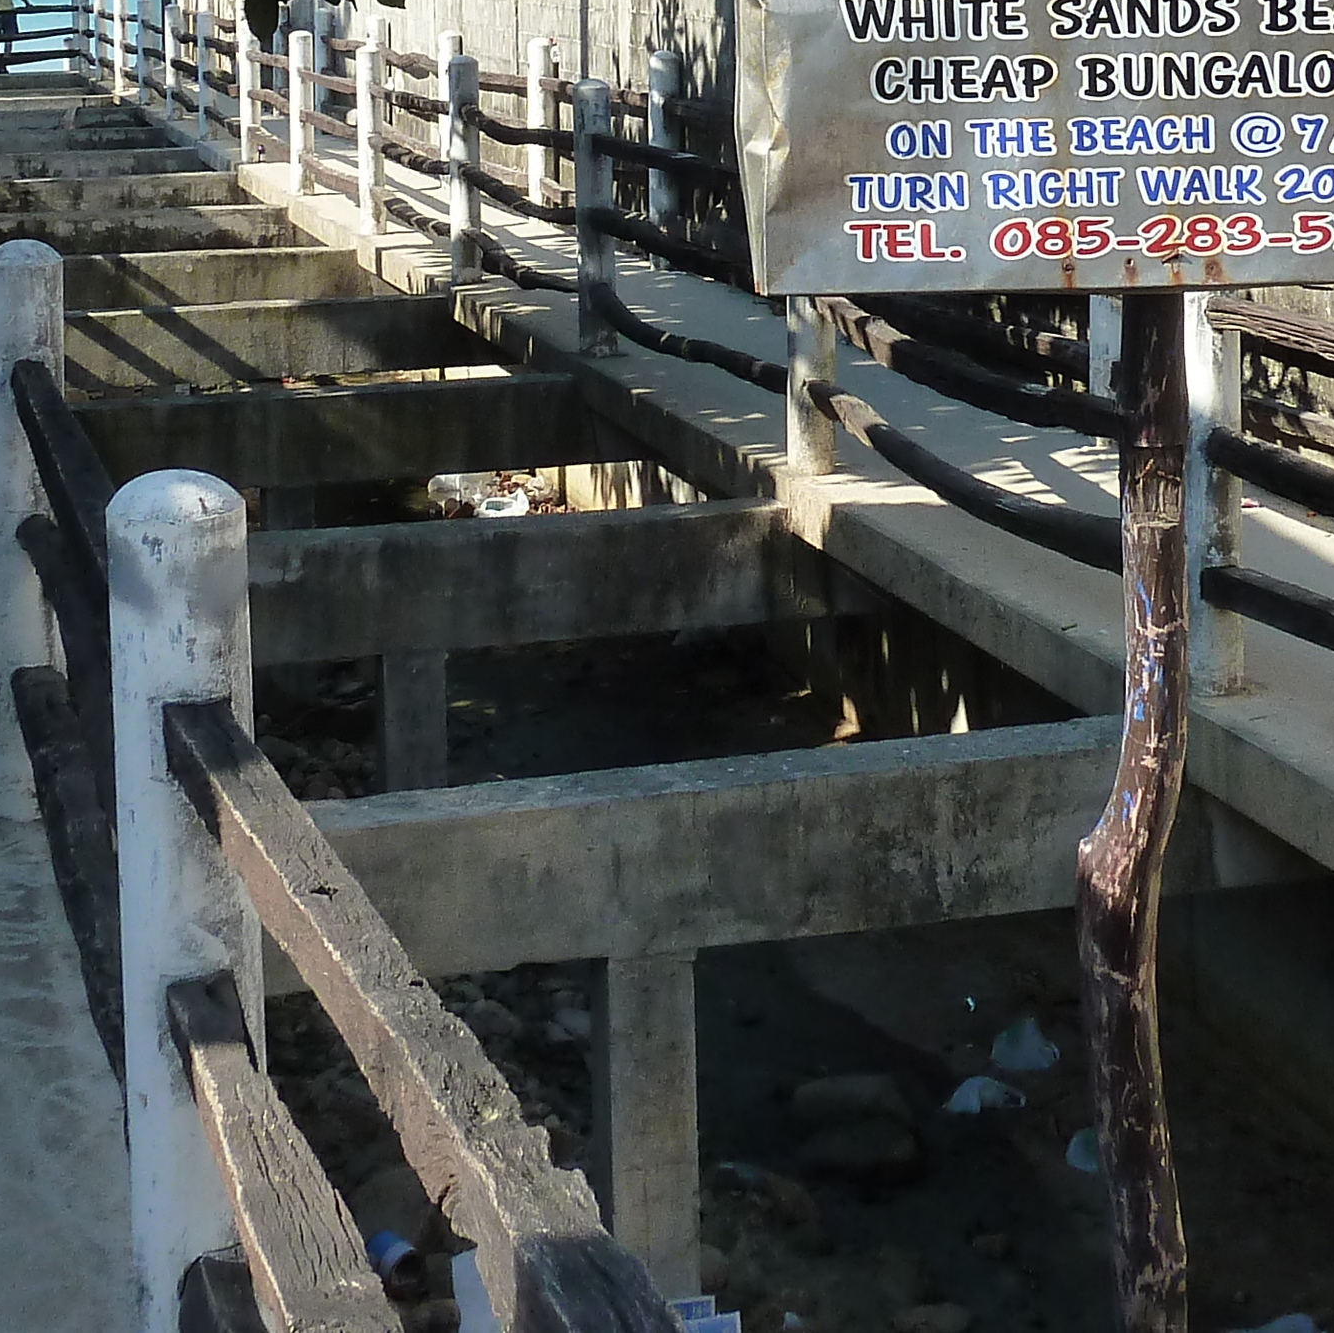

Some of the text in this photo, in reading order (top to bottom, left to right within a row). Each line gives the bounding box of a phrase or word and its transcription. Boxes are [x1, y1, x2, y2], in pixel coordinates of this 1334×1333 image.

[872, 55, 1056, 102] CHEAP
[887, 122, 949, 158] ON
[966, 119, 1055, 155] THE
[1069, 115, 1212, 154] BEACH
[1234, 114, 1282, 155] @
[846, 172, 967, 211] TURN
[985, 169, 1123, 208] RIGHT
[1138, 167, 1264, 203] WALK
[845, 221, 965, 261] TEL.
